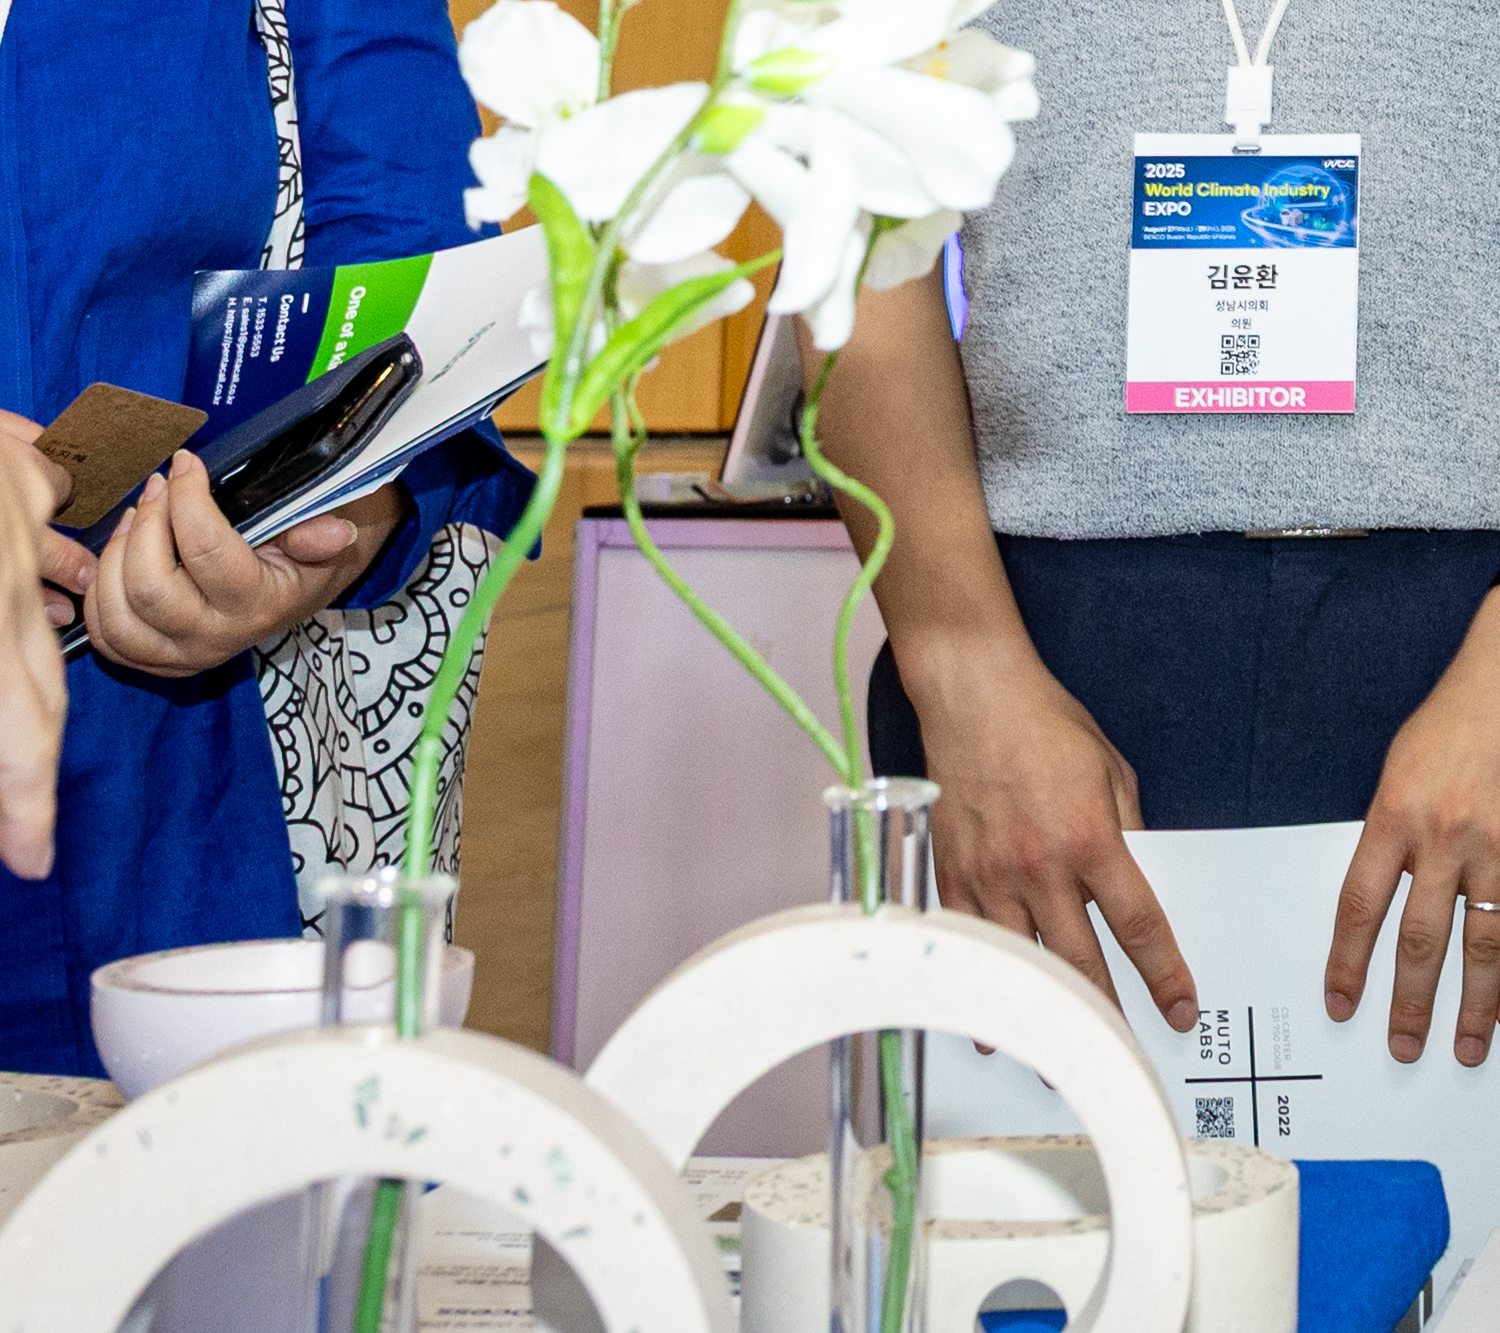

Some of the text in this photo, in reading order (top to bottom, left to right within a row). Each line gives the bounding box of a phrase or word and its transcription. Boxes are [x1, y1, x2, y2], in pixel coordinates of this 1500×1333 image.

[1143, 163, 1185, 179] 2025
[1144, 182, 1332, 200] World Climate Industry
[1143, 201, 1192, 216] EXPO
[1206, 264, 1279, 290] 김윤환
[344, 285, 367, 320] One
[1214, 299, 1269, 312] 성남시의회
[269, 293, 295, 363] Contact Us
[338, 321, 355, 339] of
[1230, 317, 1252, 330] 의원
[335, 340, 348, 351] a
[1174, 387, 1307, 408] EXHIBITOR
[1198, 1010, 1214, 1061] LABS
[1216, 1009, 1232, 1066] MUTO
[1282, 1022, 1292, 1062] CENTER
[1277, 1094, 1291, 1137] 2022
